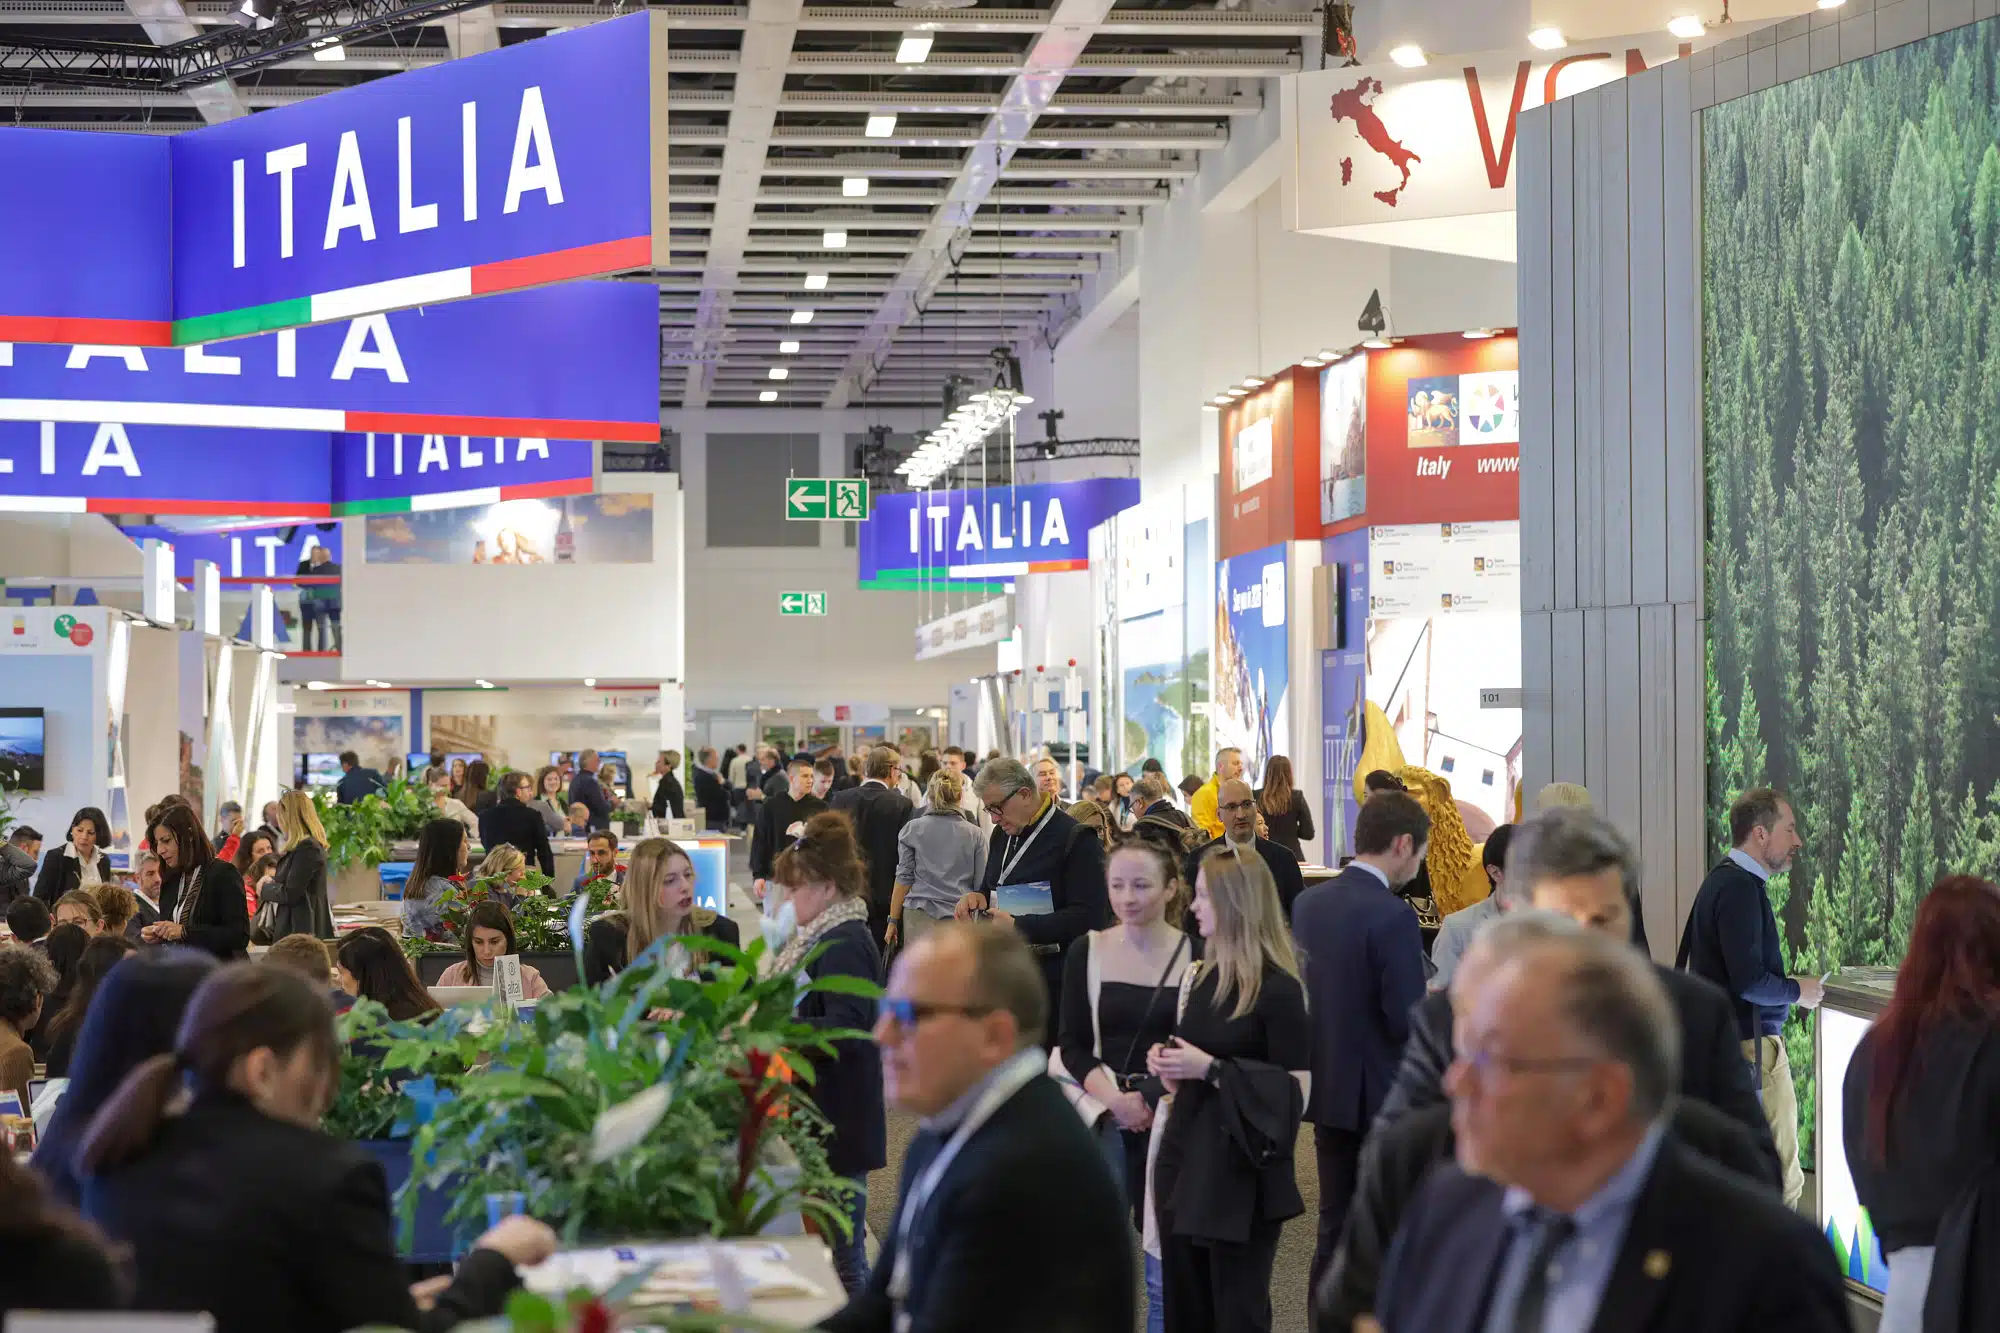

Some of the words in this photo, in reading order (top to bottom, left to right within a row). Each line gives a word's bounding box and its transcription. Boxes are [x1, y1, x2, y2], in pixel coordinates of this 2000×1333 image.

[232, 86, 565, 269] ITALIA
[1416, 455, 1452, 480] Italy
[909, 497, 1070, 553] ITALIA
[1482, 693, 1500, 703] 101
